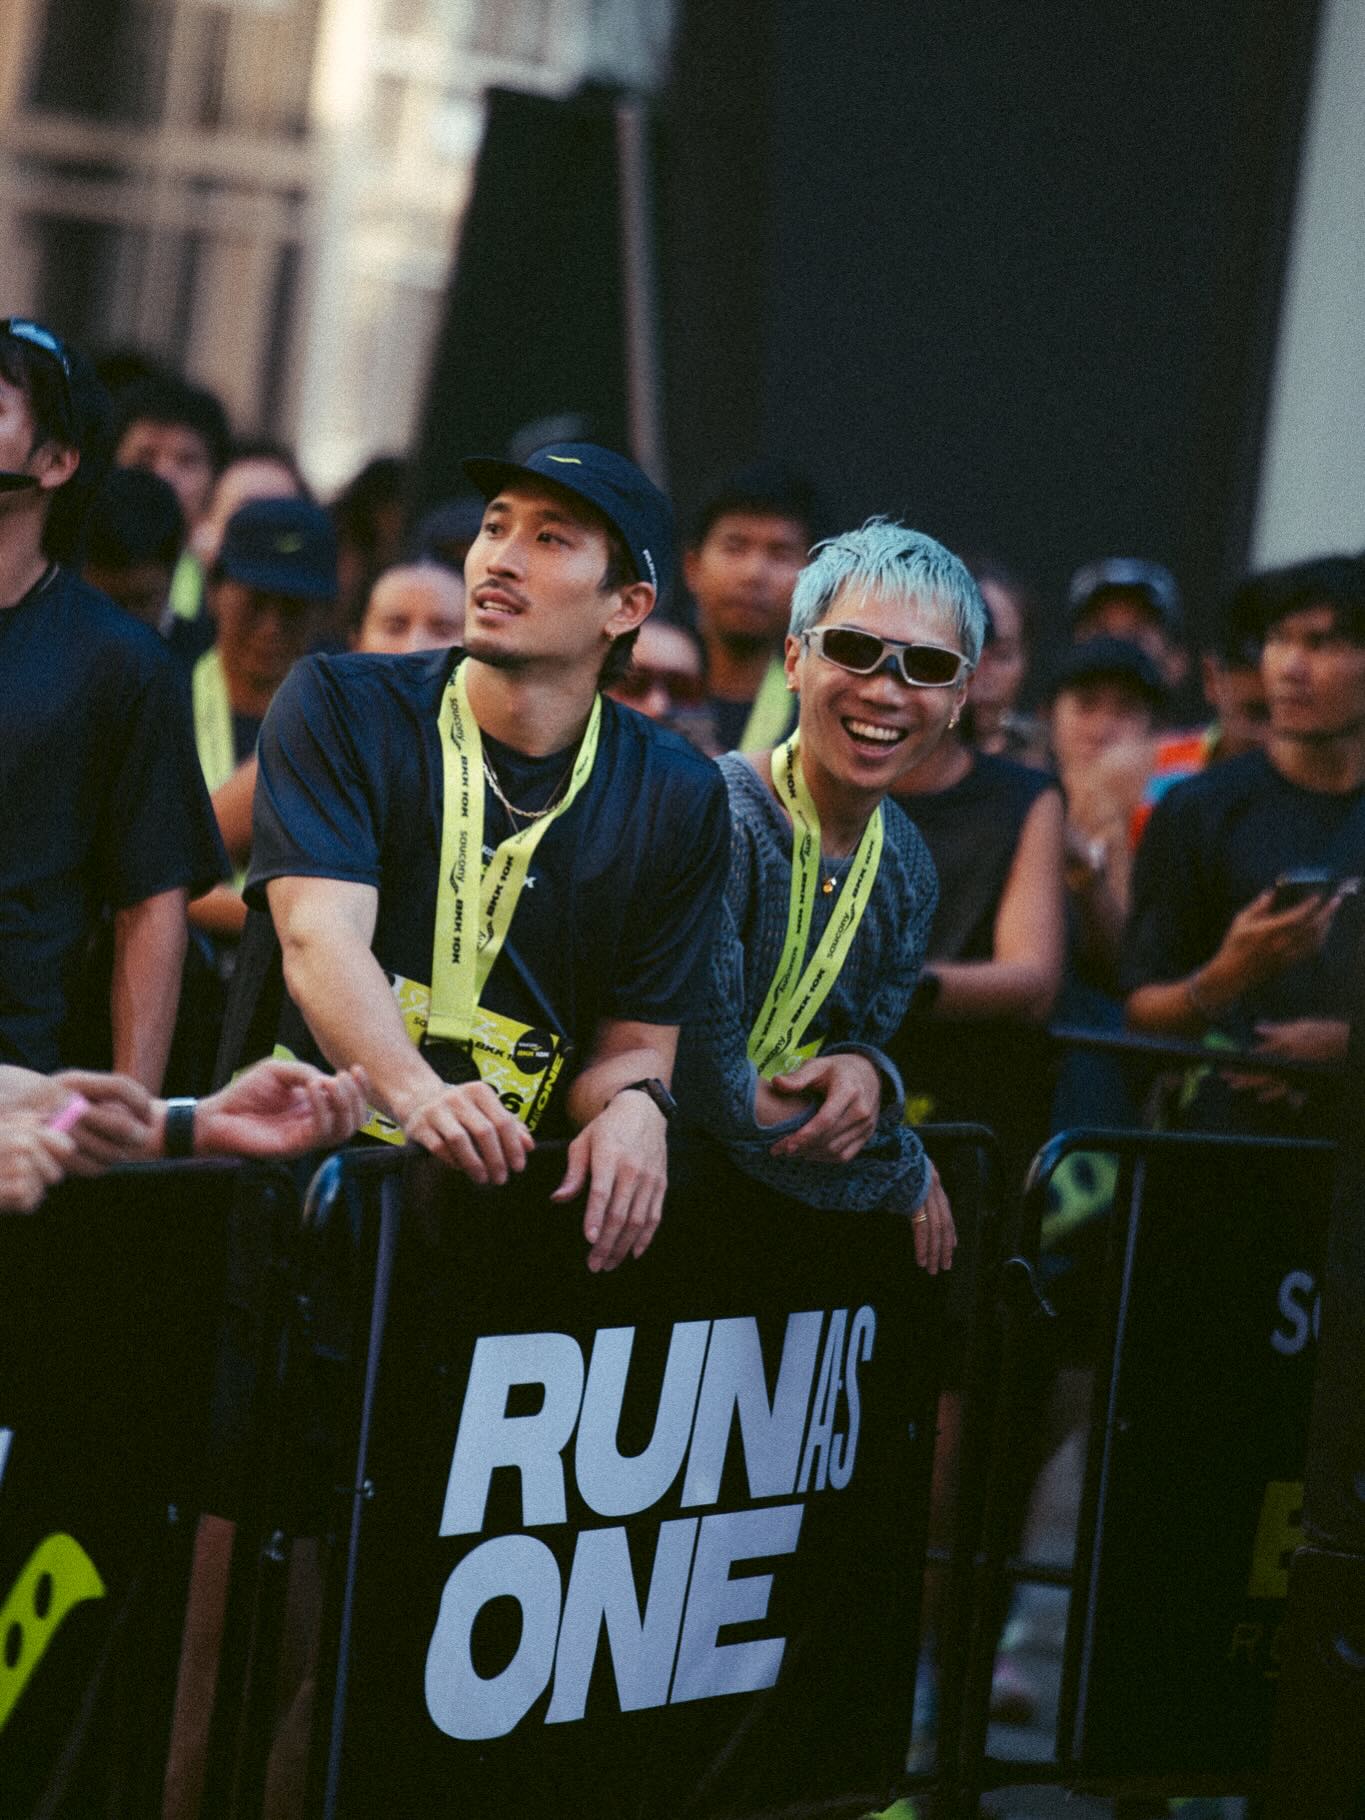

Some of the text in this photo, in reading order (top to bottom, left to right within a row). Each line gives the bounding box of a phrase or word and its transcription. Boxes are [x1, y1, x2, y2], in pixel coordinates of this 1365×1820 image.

[449, 698, 464, 742] saucony
[461, 755, 469, 818] BKK 10K
[787, 774, 796, 799] 10K
[456, 831, 468, 883] saucony
[486, 855, 514, 918] BKK 10K
[451, 899, 463, 965] BKK 10K
[827, 912, 849, 959] saucony
[791, 968, 826, 1024] BKK 10K
[438, 1305, 877, 1537] RUN AS
[424, 1503, 804, 1741] ONE
